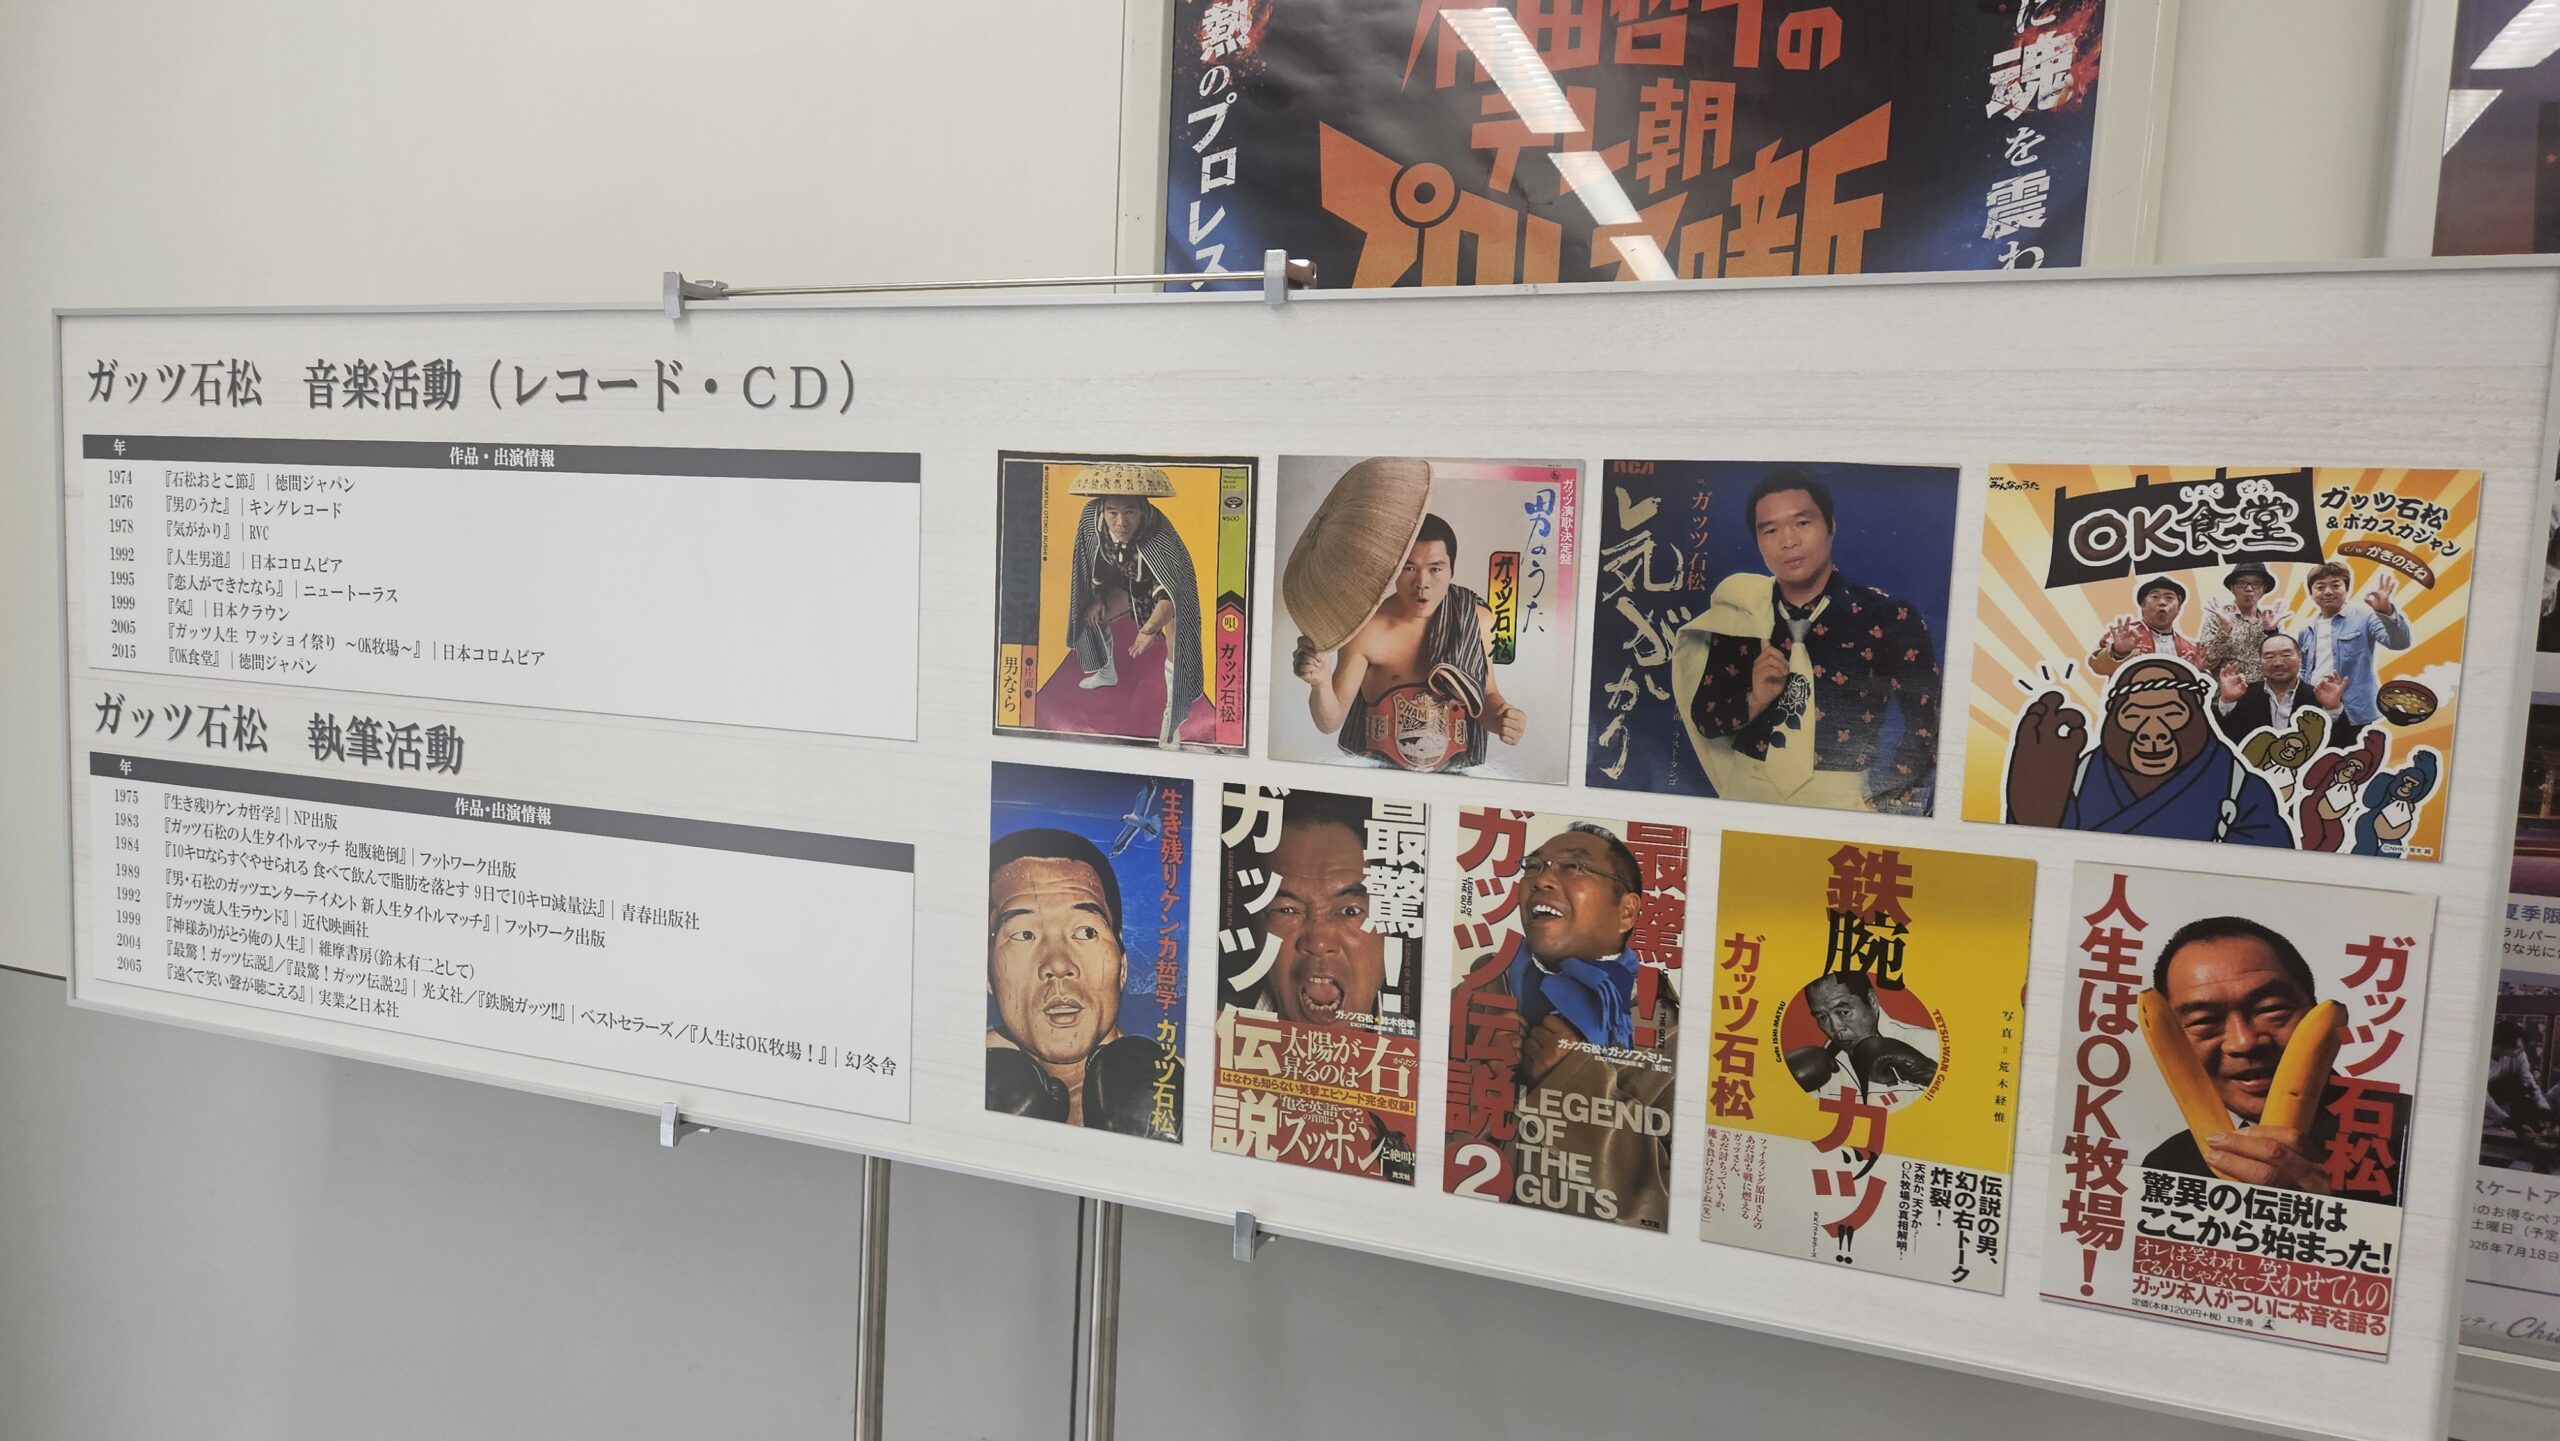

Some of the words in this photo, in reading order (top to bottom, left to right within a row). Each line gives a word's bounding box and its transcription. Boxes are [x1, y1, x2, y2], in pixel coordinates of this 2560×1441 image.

[87, 357, 263, 408] ガッツ石松
[113, 439, 127, 456] 年
[449, 446, 556, 469] 作品・出演情報
[1614, 461, 1655, 474] RCA
[108, 470, 133, 485] 1974
[164, 470, 256, 492] 『石松おとこ節』
[275, 473, 356, 494] 徳間ジャパン
[109, 494, 133, 510] 1976
[165, 496, 231, 515] 『男のうた』
[249, 500, 343, 519] キングレコード
[1989, 480, 2040, 491] みんなのうた
[109, 519, 134, 534] 1978
[166, 520, 231, 541] 『気がかり』
[249, 525, 270, 542] RVC
[2072, 498, 2299, 560] OK食堂
[2320, 486, 2449, 531] ガッツ石松
[2326, 516, 2339, 529] &
[110, 547, 134, 562] 1992
[166, 549, 232, 569] 『人生男道』
[250, 554, 343, 575] 日本コロムビア
[1520, 488, 1556, 633] 男のうた
[1687, 491, 1712, 591] ガッツ石松
[2366, 546, 2428, 580] かきのたね
[110, 571, 135, 587] 1995
[167, 573, 284, 599] 『恋人ができたなら』
[303, 584, 398, 604] ニュートーラス
[111, 596, 135, 611] 1999
[168, 598, 194, 617] 『気』
[212, 601, 290, 622] 日本クラウン
[1488, 555, 1515, 661] ガッツ石松
[111, 620, 136, 636] 2005
[168, 623, 239, 644] 『ガッツ人生
[245, 627, 336, 652] ワッショイ祭り
[442, 643, 546, 668] 日本コロムビア
[1224, 616, 1236, 630] 唄
[112, 644, 136, 660] 2015
[169, 647, 221, 668] 『OK食堂』
[239, 653, 318, 675] 徳間ジャパン
[1003, 656, 1018, 713] 男なら
[1220, 643, 1237, 723] ガッツ石松
[95, 691, 269, 753] ガッツ石松
[307, 712, 465, 776] 執筆活動
[114, 788, 139, 804] 1975
[164, 793, 280, 824] 『生き残りケンカ哲学』
[294, 810, 338, 831] NP出版
[119, 758, 133, 776] 年
[454, 796, 552, 826] 作品・出演情報
[114, 812, 139, 828] 1983
[165, 817, 340, 854] 『ガッツ石松の人生タイトルマッチ
[345, 840, 407, 865] 抱腹絶倒』
[419, 850, 517, 879] フットワーク出版
[115, 836, 140, 852] 1984
[165, 841, 309, 876] 『10キロならすぐやせられる
[313, 861, 470, 899] 食べて飲んで脂肪を落とす
[474, 884, 605, 918] 9日で10キロ減量法』
[620, 903, 700, 931] 青春出版社
[115, 863, 140, 879] 1989
[166, 868, 357, 912] 『男・石松のガッツエンターテイメント
[361, 896, 490, 932] 新人生タイトルマッチ』
[504, 917, 606, 948] フットワーク出版
[116, 886, 141, 902] 1992
[166, 892, 289, 926] 『ガッツ流人生ラウンド』
[302, 913, 369, 938] 近代映画社
[116, 910, 141, 926] 1999
[167, 916, 305, 954] 『神様ありがとう俺の人生』
[1823, 844, 1914, 992] 鉄腕
[117, 957, 142, 973] 2005
[319, 989, 400, 1019] 実業之日本社
[1212, 783, 1291, 1161] ガッツ伝説
[1445, 807, 1535, 1141] ガッツ伝説
[116, 934, 141, 950] 2004
[845, 1050, 897, 1077] 幻冬舎
[1709, 932, 1766, 1121] ガッツ石松
[1772, 1000, 1787, 1046] ISHI-MATSU
[1281, 1027, 1361, 1064] 太陽が
[1933, 1009, 1951, 1073] TETSU-WAN
[2324, 934, 2416, 1197] ガッツ石松
[1282, 1056, 1360, 1088] 昇るのは
[1518, 1085, 1671, 1137] LEGEND
[1518, 1115, 1568, 1147] OF
[1453, 1144, 1501, 1200] 2
[1515, 1142, 1592, 1184] THE
[1742, 1135, 1755, 1219] あだ討ち戦に燃える
[1753, 1138, 1767, 1230] ファイティング原田さんの
[1515, 1173, 1618, 1220] GUTS
[1976, 1175, 2002, 1265] 伝説の男、
[2140, 1170, 2348, 1233] 驚異の伝説は
[2473, 1203, 2560, 1226] のお得なペア
[1952, 1171, 1978, 1283] 幻の右トーク
[2136, 1204, 2392, 1275] ここから始まった!
[2135, 1258, 2256, 1292] てるんじゃなくて
[2137, 1238, 2246, 1271] オレは笑われ
[2132, 1275, 2387, 1337] ガッツ本人がついに本音を語る
[2256, 1259, 2389, 1312] 笑わせてんの
